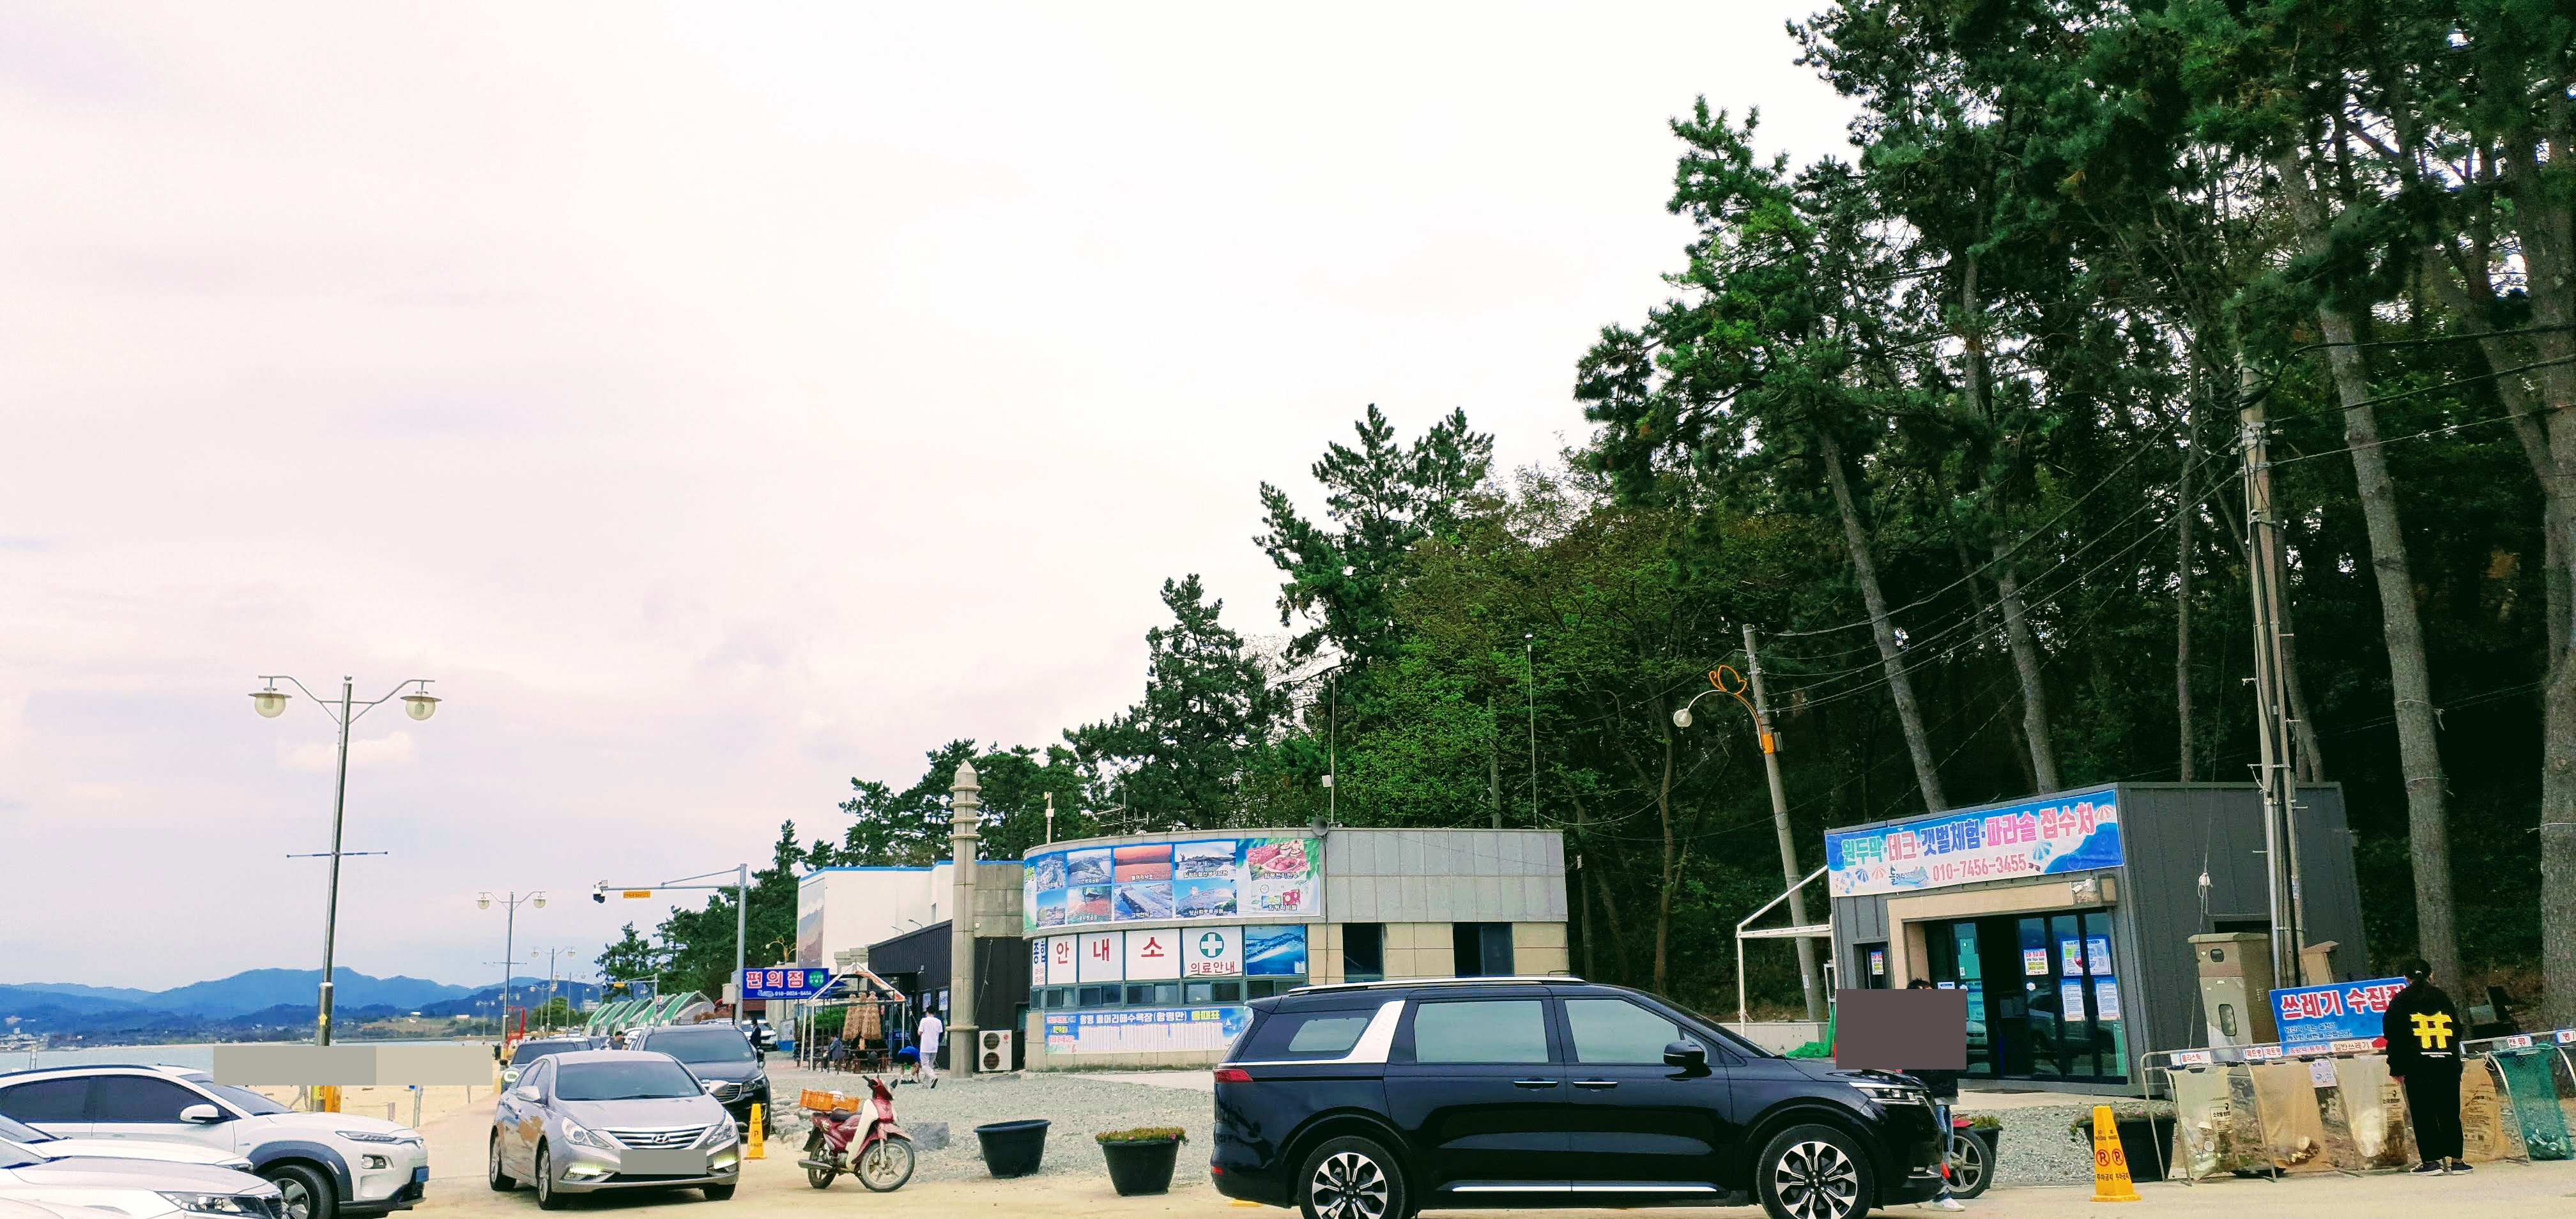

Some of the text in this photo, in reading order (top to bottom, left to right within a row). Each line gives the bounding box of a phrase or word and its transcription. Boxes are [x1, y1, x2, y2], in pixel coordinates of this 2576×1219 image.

[2041, 802, 2096, 839] 접수처
[1933, 854, 2027, 882] 010-7456-3455
[746, 970, 804, 988] 편의점
[1190, 961, 1235, 974] 의료안내
[2281, 990, 2344, 1020] 쓰레기
[2333, 1041, 2370, 1051] 일반쓰레기
